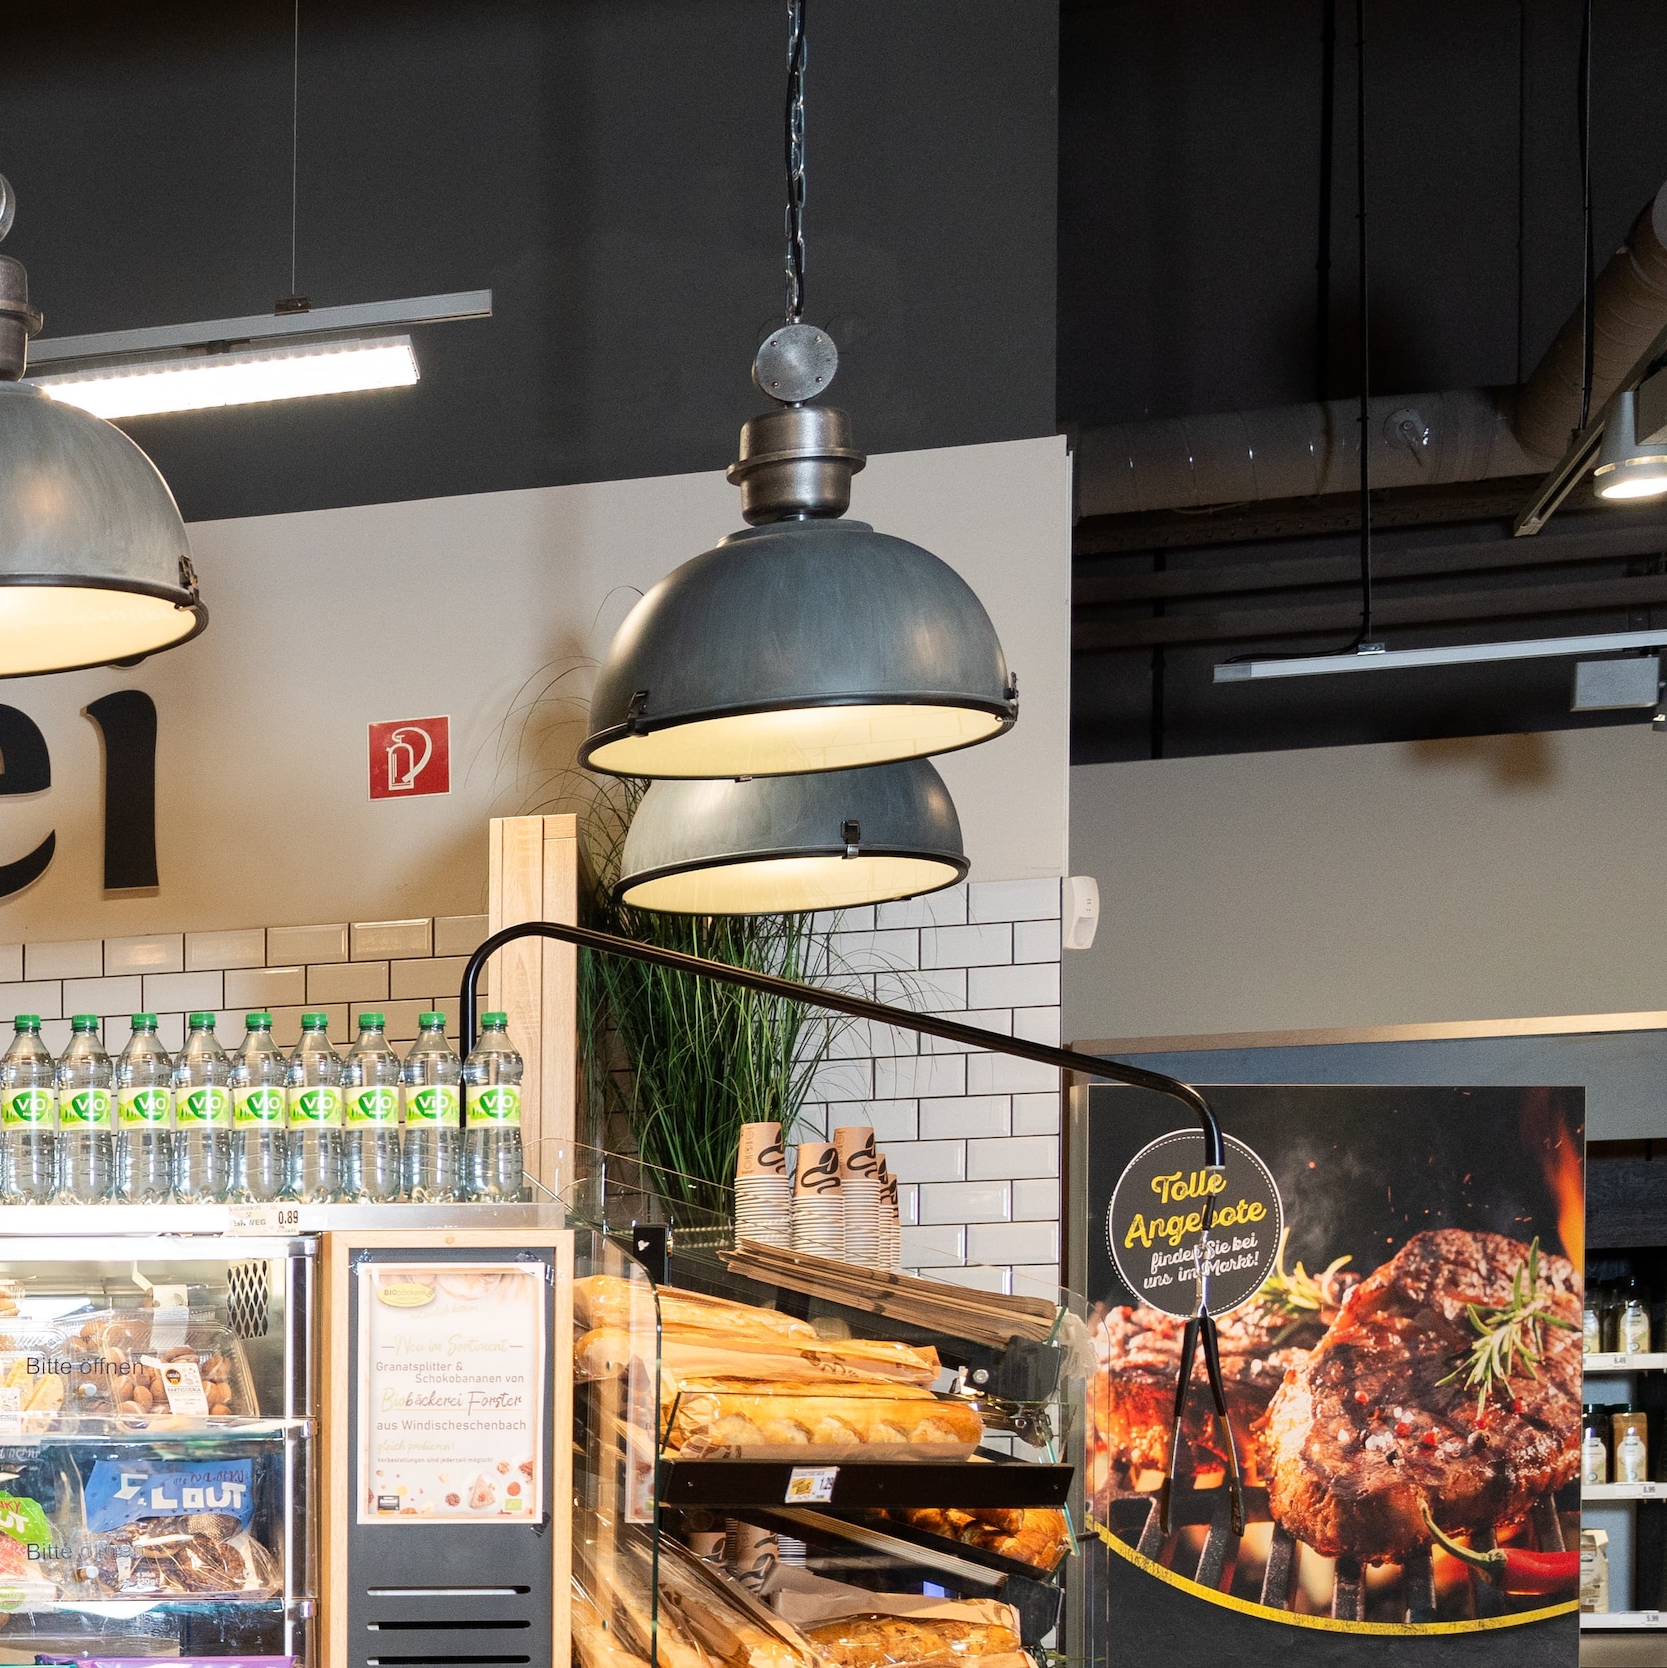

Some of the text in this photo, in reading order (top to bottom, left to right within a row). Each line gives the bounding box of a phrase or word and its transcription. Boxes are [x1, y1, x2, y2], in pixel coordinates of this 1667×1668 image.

[1151, 1170, 1227, 1204] Tolle
[1233, 1232, 1258, 1251] bei
[1143, 1274, 1173, 1289] uns
[1201, 1251, 1259, 1276] Markt!
[26, 1356, 145, 1376] Bitte öffnen
[376, 1362, 463, 1373] Granatsplitter &
[415, 1374, 524, 1383] Schokobananen von
[376, 1420, 526, 1430] aus Windischeschenbach
[27, 1542, 72, 1560] Bitte
[1645, 1614, 1659, 1622] 5.99
